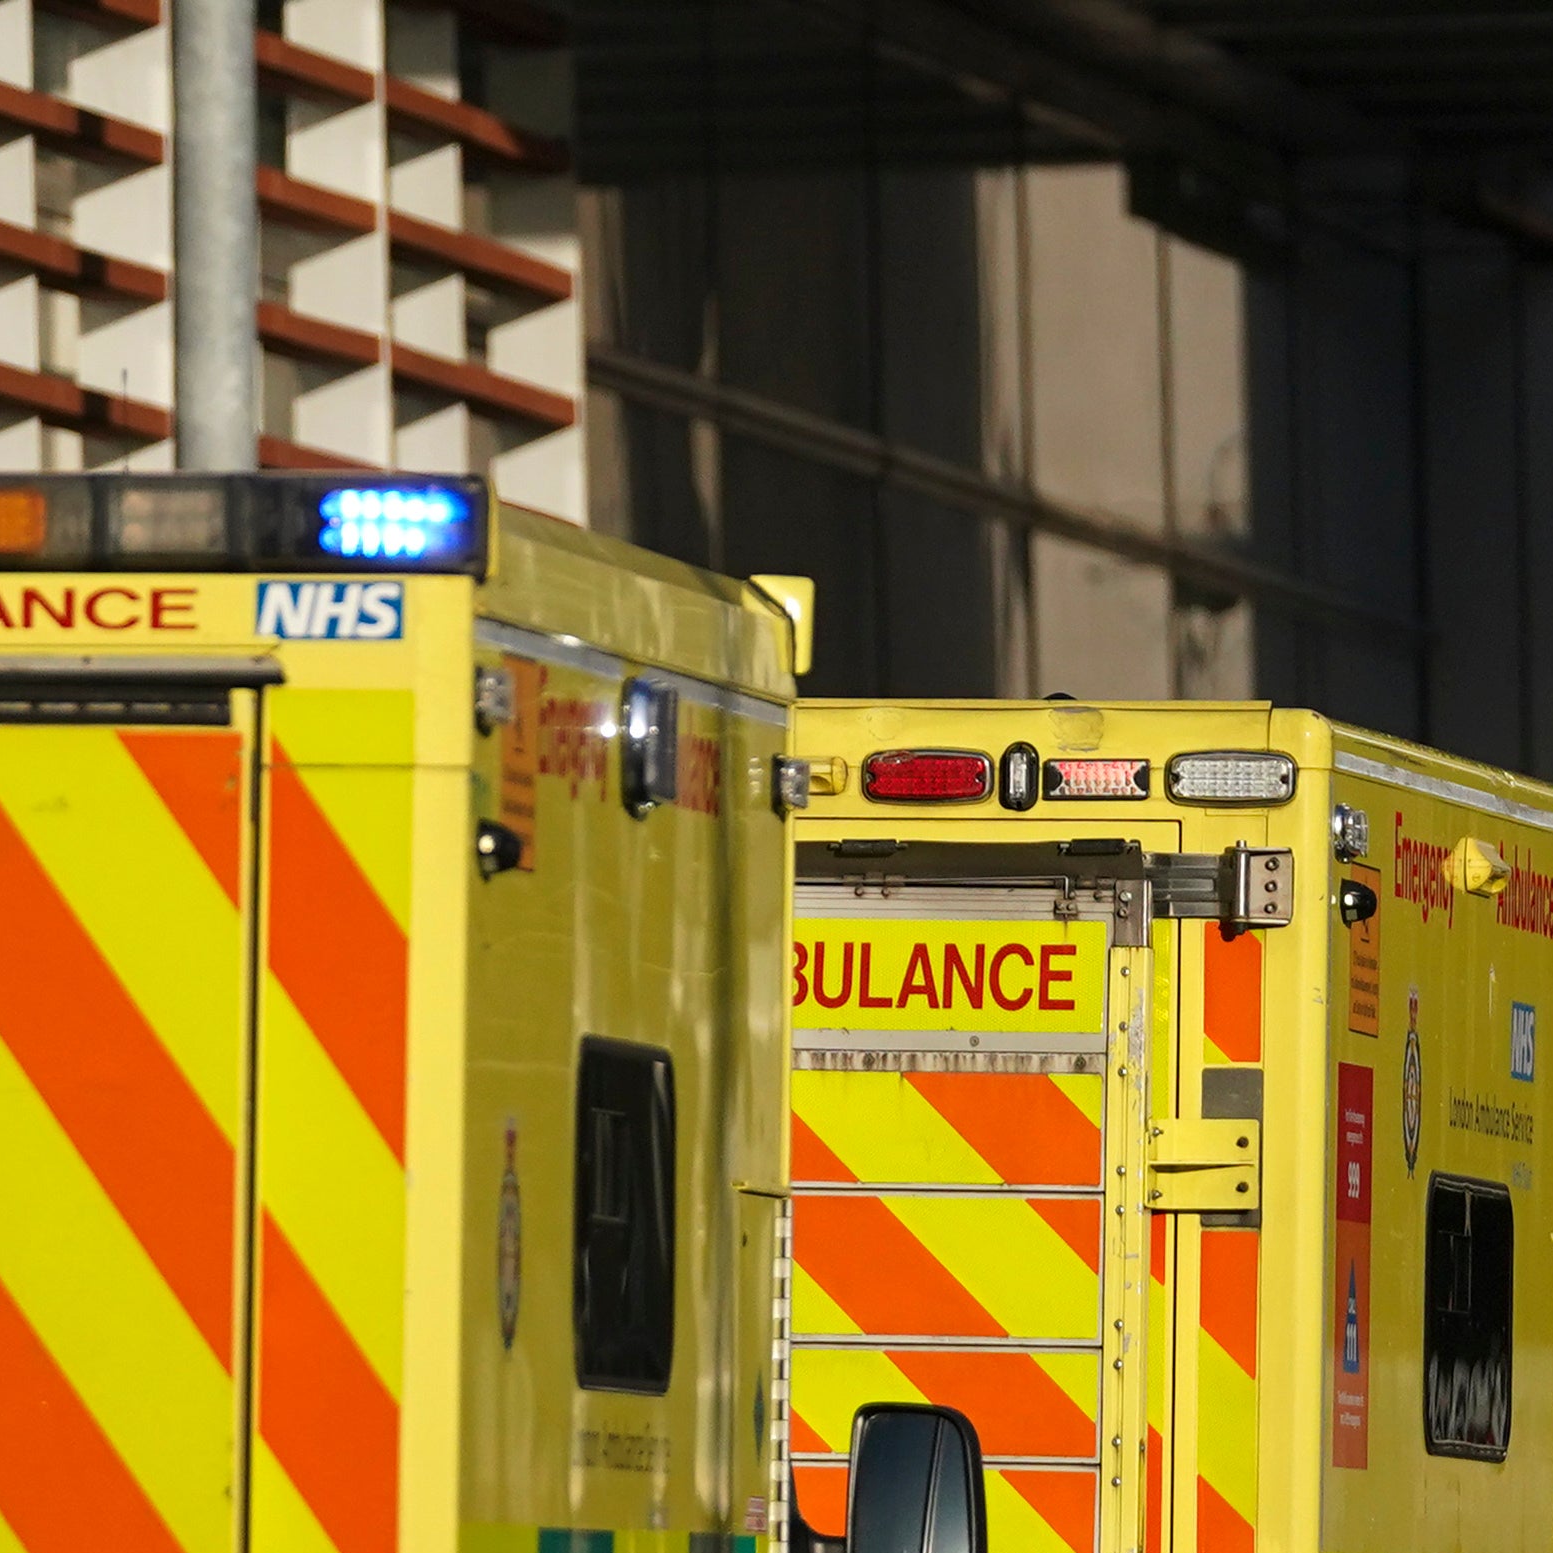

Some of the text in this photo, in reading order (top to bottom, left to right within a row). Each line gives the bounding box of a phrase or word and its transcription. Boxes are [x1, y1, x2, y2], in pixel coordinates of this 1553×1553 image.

[258, 582, 401, 638] NHS
[1511, 1006, 1536, 1077] NHS
[1474, 1093, 1510, 1139] Ambulance
[1511, 1101, 1534, 1144] Service
[1348, 1162, 1360, 1198] 999
